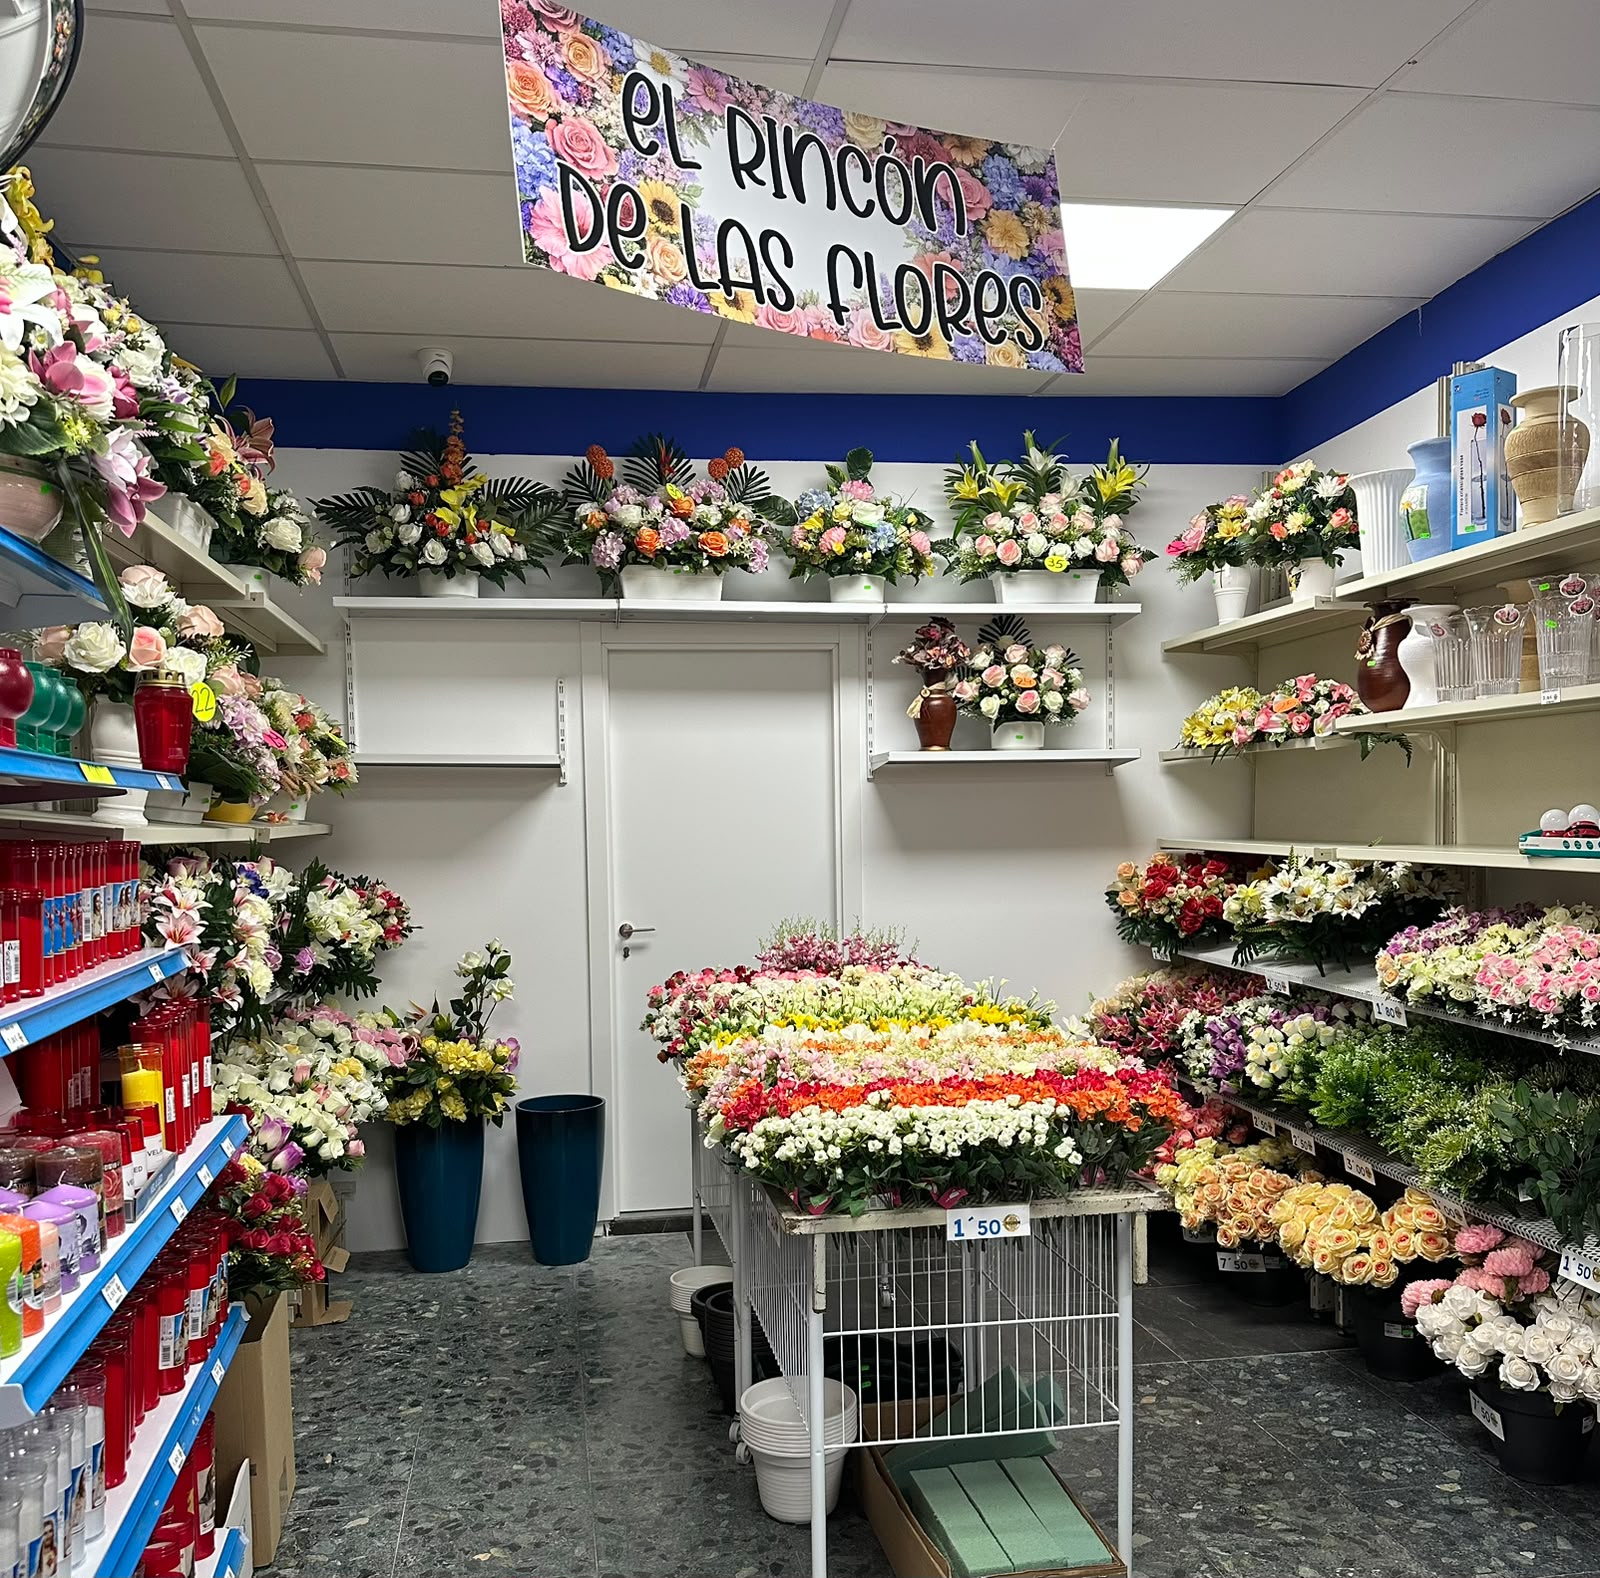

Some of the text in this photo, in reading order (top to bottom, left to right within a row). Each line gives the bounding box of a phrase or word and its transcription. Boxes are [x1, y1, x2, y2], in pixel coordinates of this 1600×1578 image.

[681, 203, 795, 312] LAS
[1048, 558, 1065, 569] 35
[191, 686, 214, 713] 22
